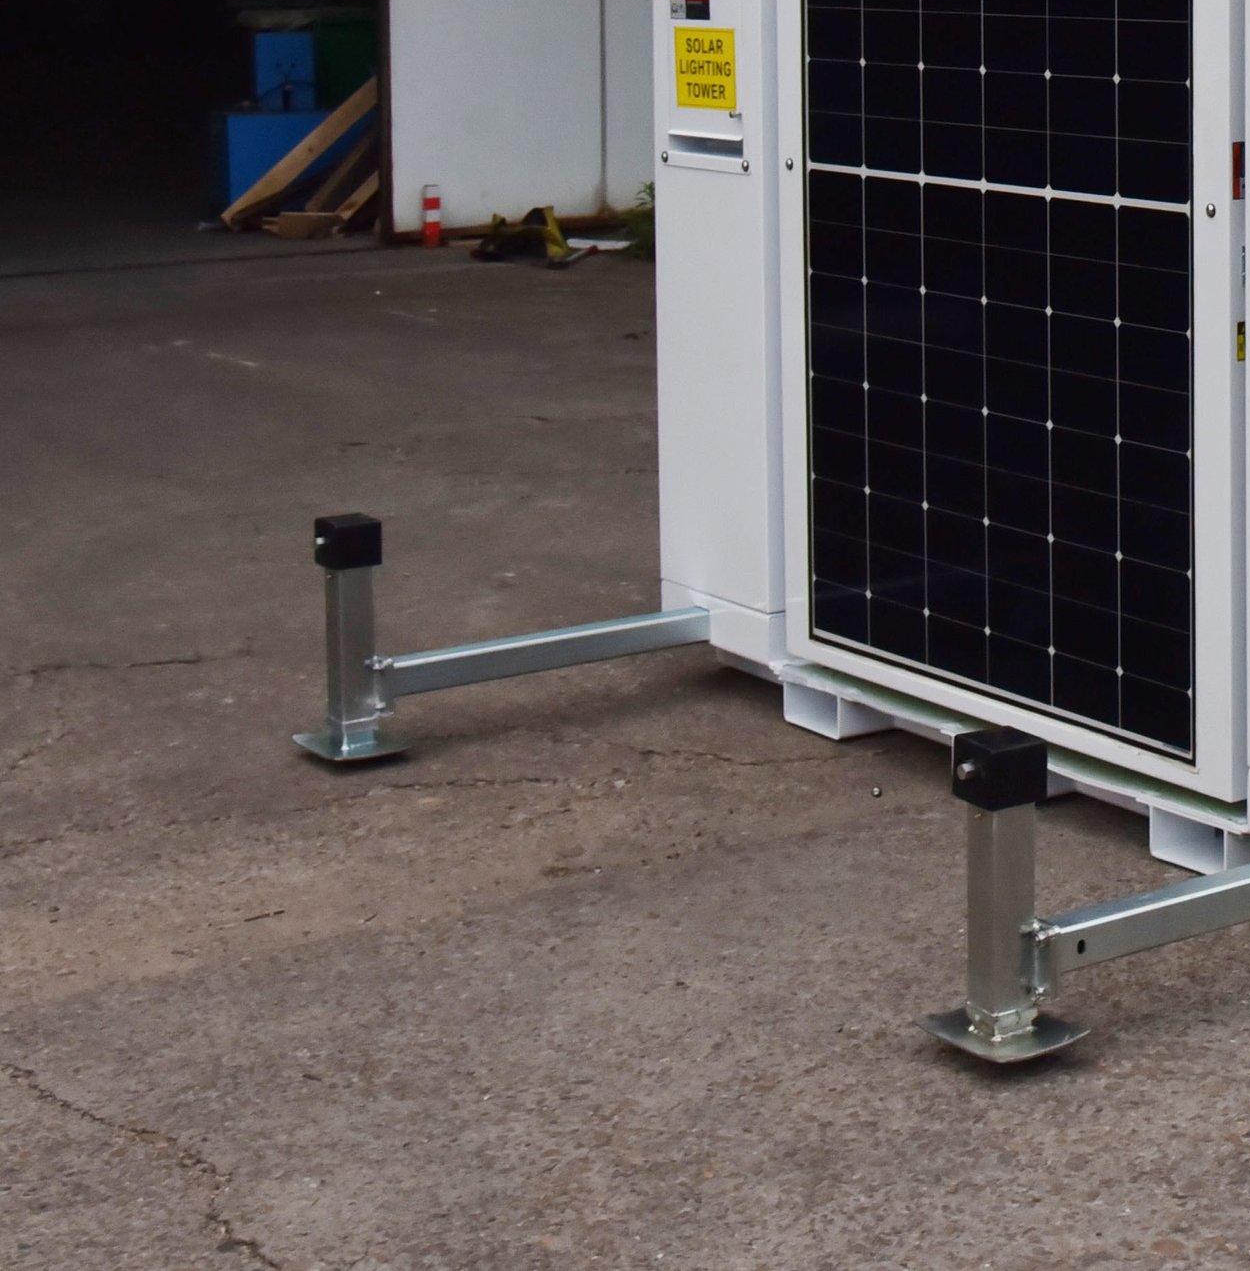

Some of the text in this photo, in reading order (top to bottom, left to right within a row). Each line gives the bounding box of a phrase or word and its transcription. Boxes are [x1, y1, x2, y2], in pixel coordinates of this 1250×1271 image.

[686, 38, 723, 54] SOLAR
[680, 60, 731, 76] LIGHTING
[687, 83, 725, 99] TOWER
